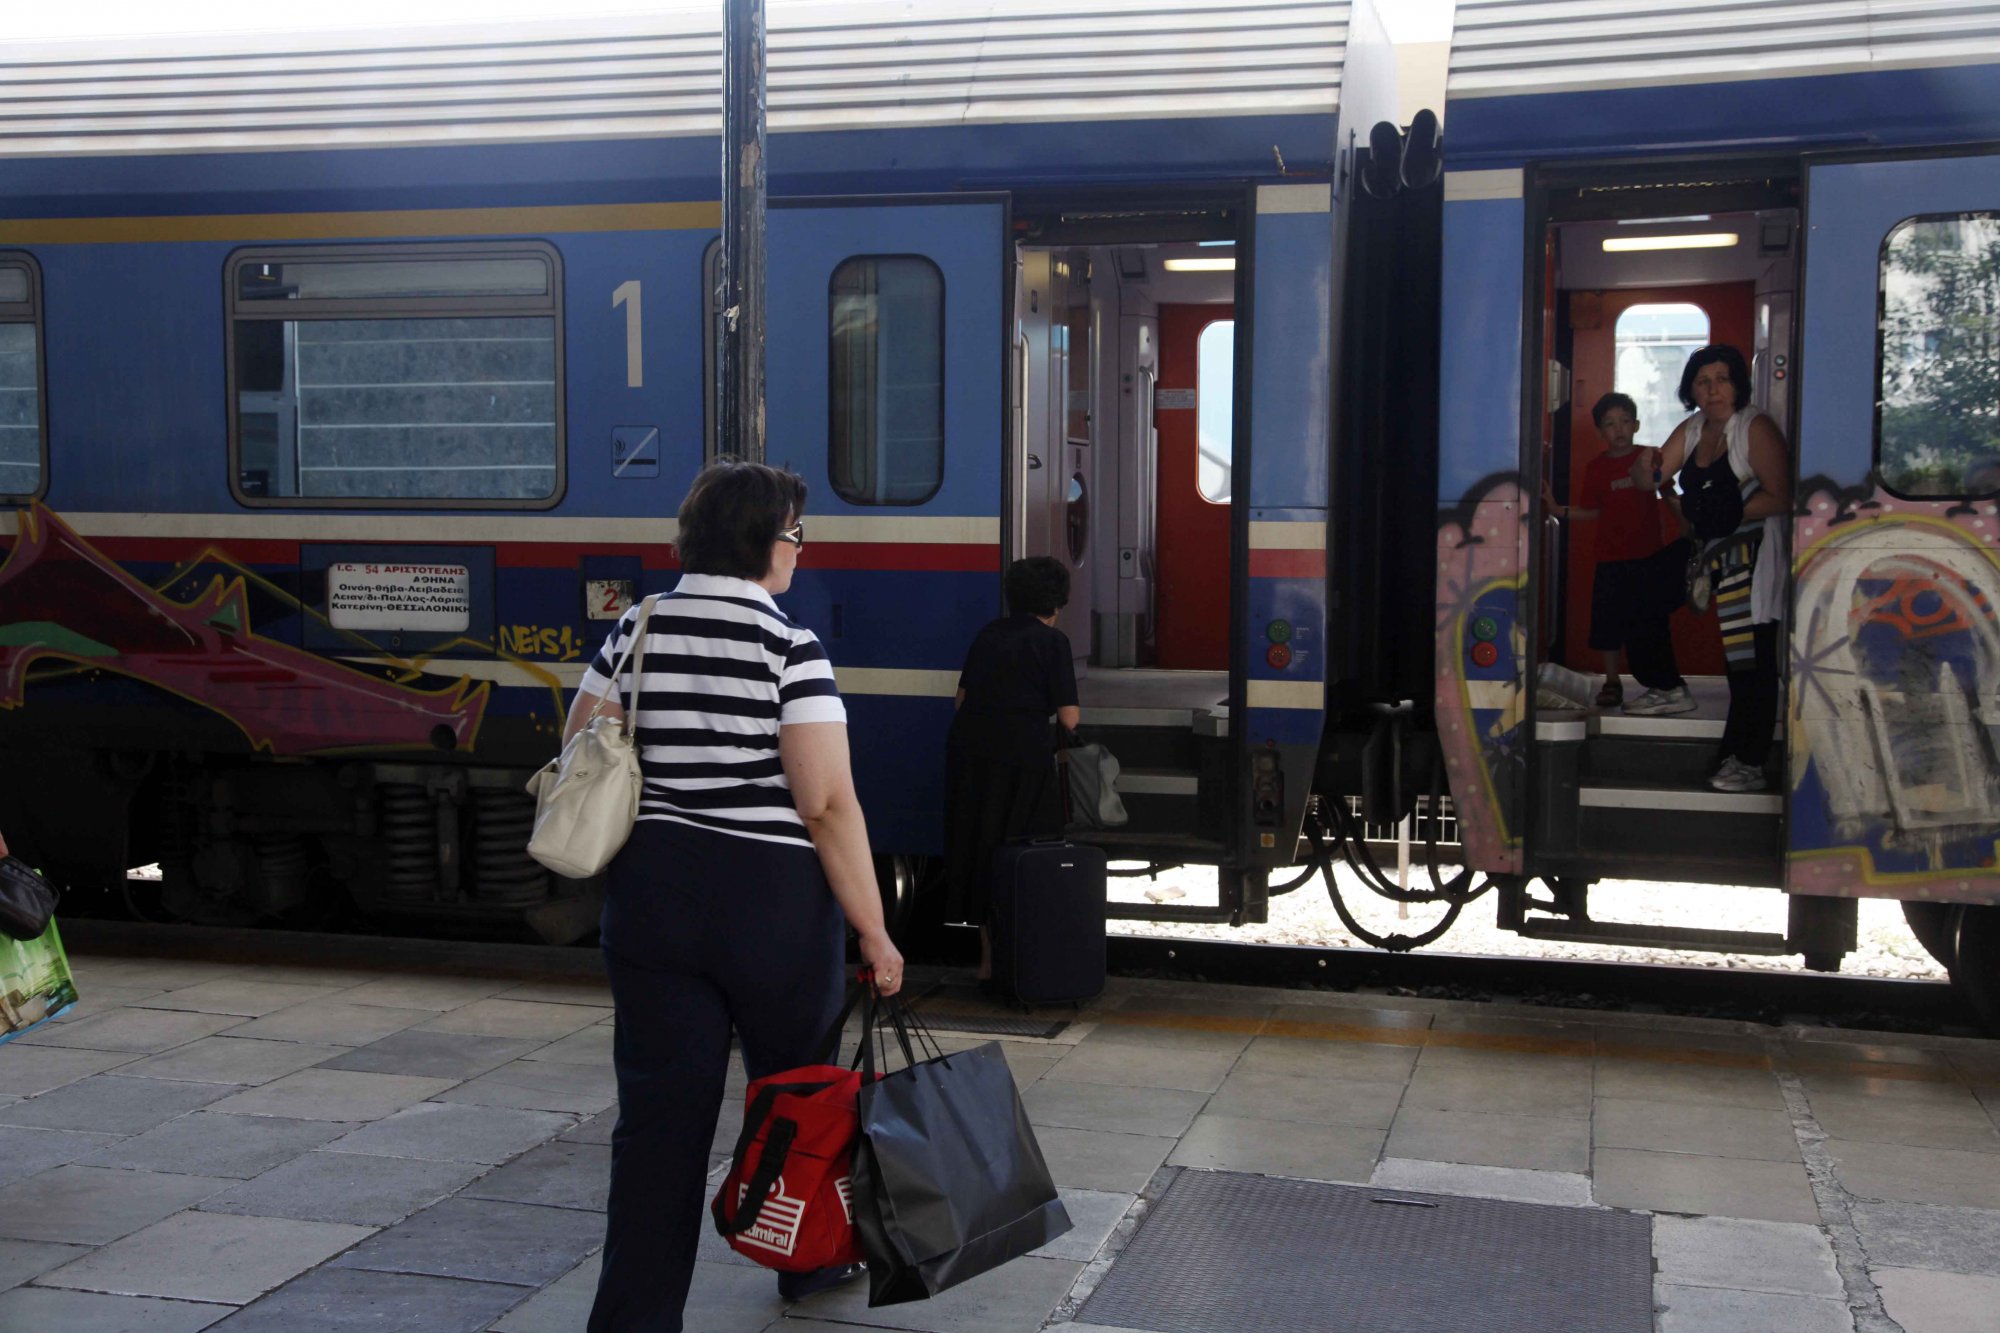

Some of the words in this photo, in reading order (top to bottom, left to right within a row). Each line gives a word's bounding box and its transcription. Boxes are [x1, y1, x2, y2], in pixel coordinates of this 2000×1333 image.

[612, 280, 643, 388] 1
[365, 565, 379, 575] 54
[384, 566, 466, 576] ΑΡΙΣΤΟΤΕΛΗΣ
[413, 576, 455, 584] ΑΘΗΝΑ
[602, 588, 620, 612] 2
[743, 1222, 789, 1249] dmiral
